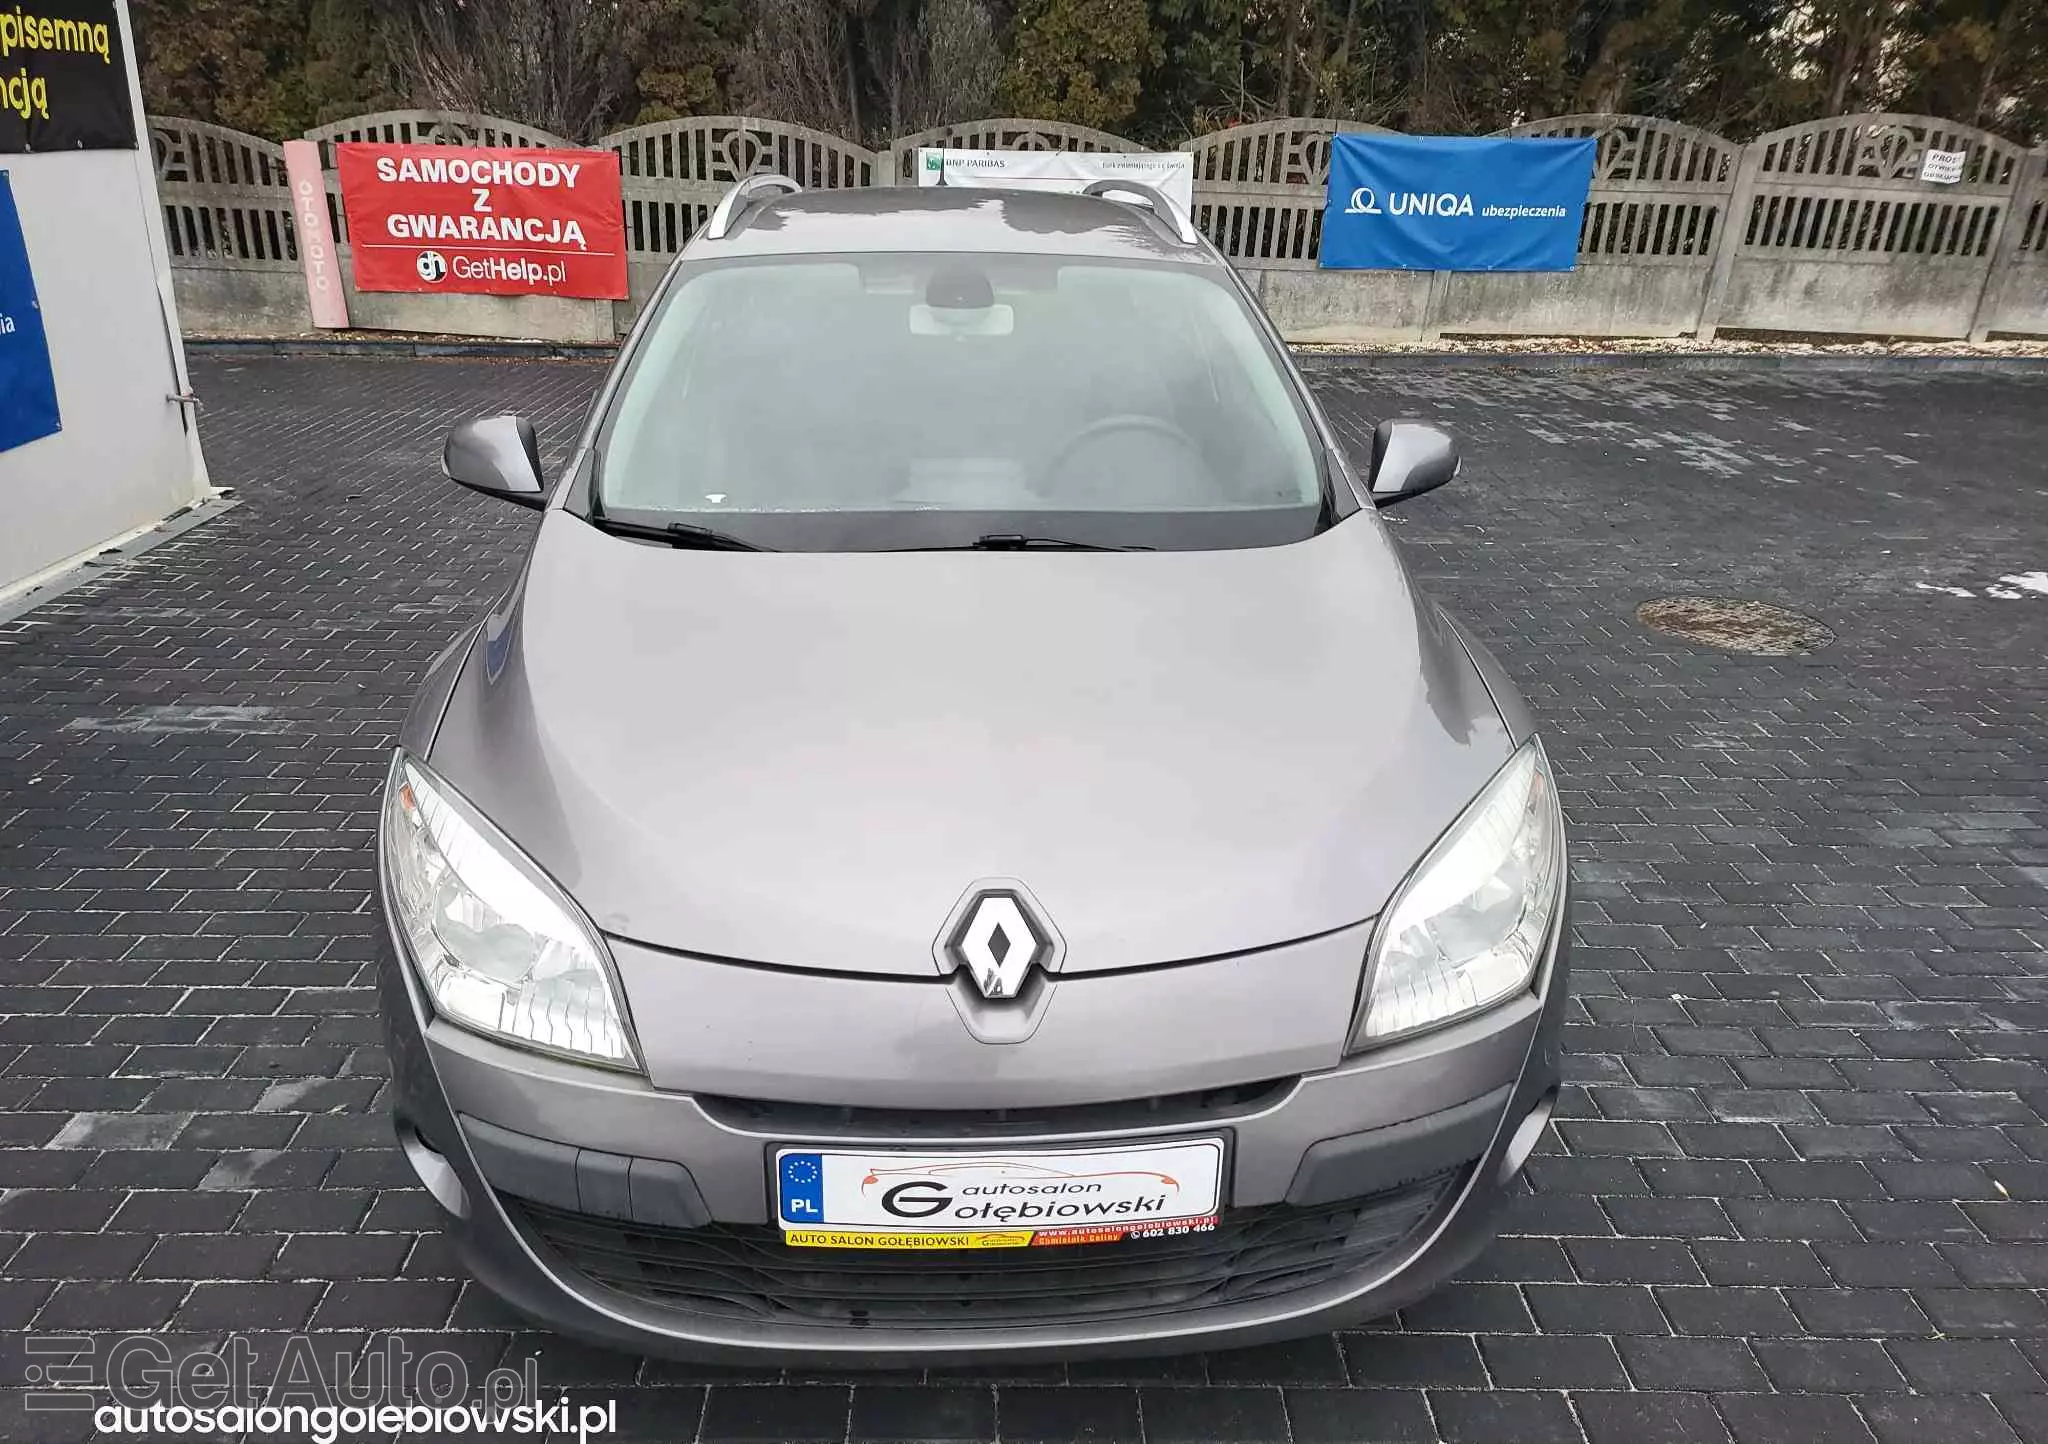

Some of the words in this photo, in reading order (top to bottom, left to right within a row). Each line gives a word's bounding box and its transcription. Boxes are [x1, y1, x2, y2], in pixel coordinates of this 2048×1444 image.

[0, 5, 110, 64] pisemną
[377, 158, 580, 188] SAMOCHODY
[471, 188, 493, 213] Z
[1388, 193, 1474, 217] UNIQA
[1481, 204, 1566, 220] ubezpieczenia
[387, 214, 588, 251] GWARANCJĄ
[452, 255, 567, 286] GetHelp.pl
[962, 1183, 1102, 1196] autosalon
[791, 1199, 819, 1213] PL
[790, 1233, 827, 1244] AUTO
[830, 1235, 874, 1245] SALON
[1142, 1229, 1165, 1239] 602
[1167, 1226, 1190, 1236] 830
[1192, 1223, 1215, 1233] 466
